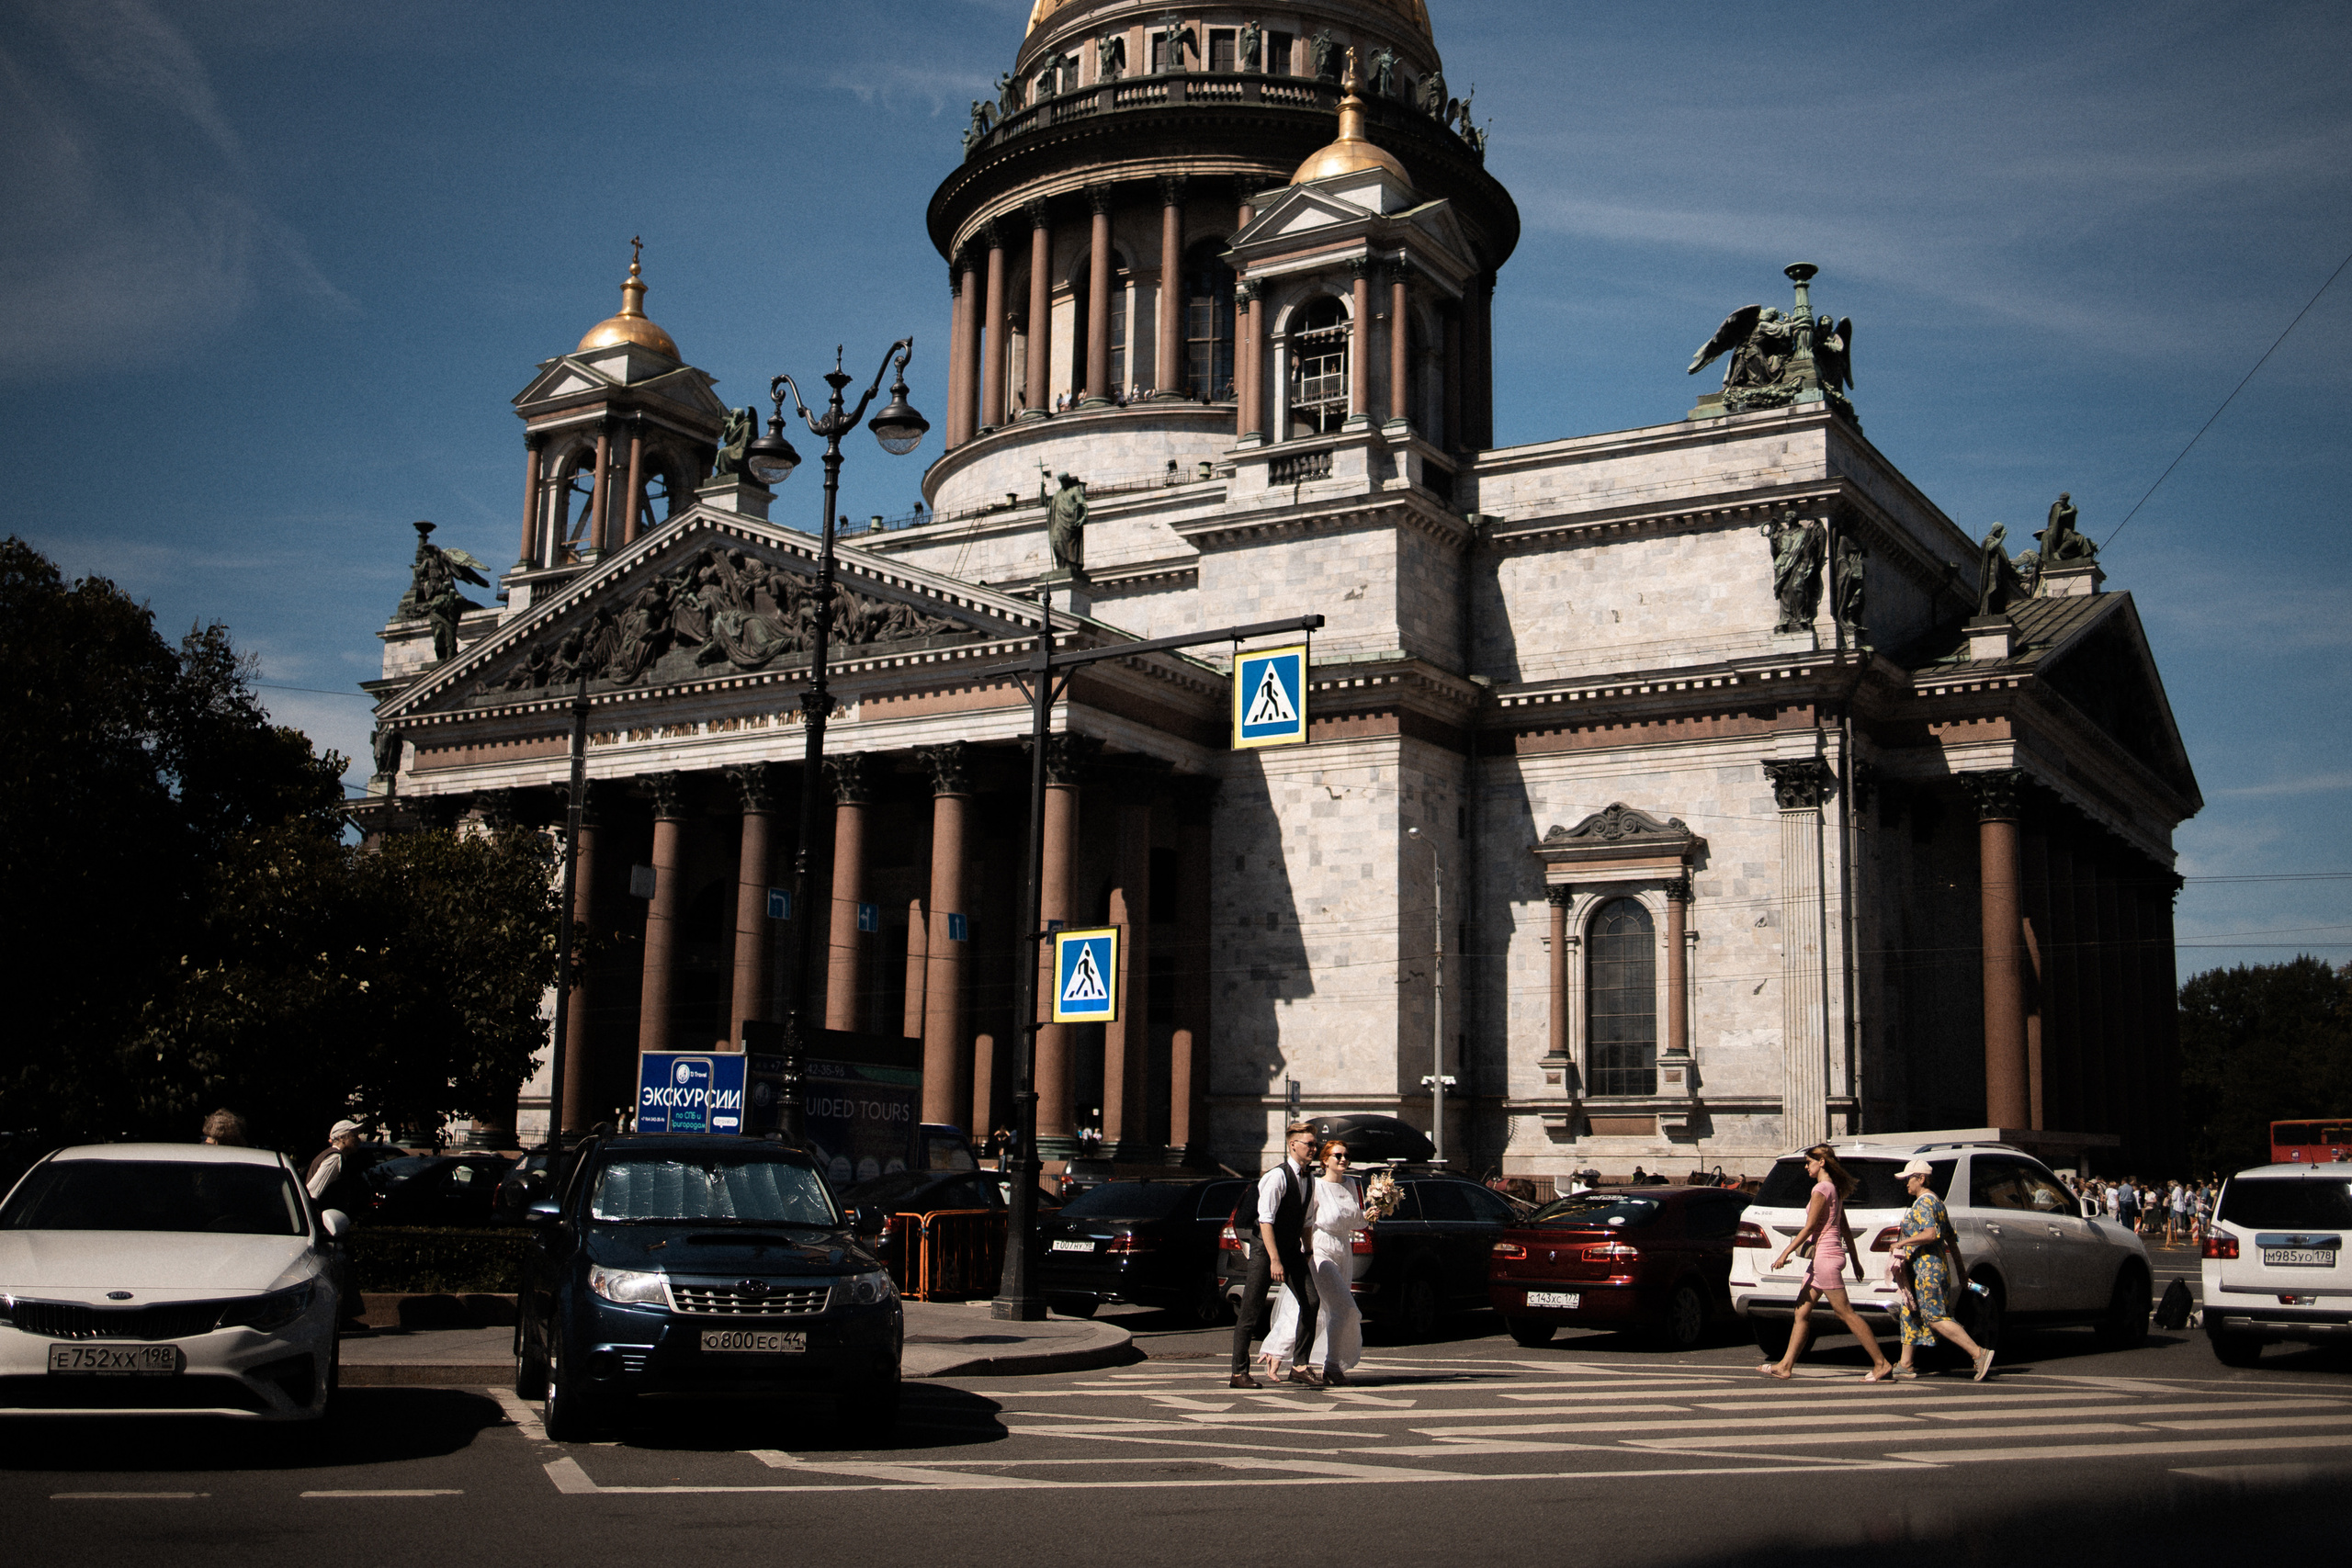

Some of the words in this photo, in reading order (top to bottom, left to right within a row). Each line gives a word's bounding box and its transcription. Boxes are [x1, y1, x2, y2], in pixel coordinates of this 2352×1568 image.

[642, 1087, 741, 1110] ЭКСКУРСИИ
[805, 1096, 855, 1119] UIDED
[859, 1100, 910, 1122] TOURS
[2267, 1250, 2312, 1262] М985УО
[2314, 1250, 2331, 1260] 178
[1564, 1292, 1577, 1302] 177
[783, 1331, 800, 1346] 44
[57, 1348, 137, 1368] Е752ХХ
[140, 1348, 172, 1363] 198
